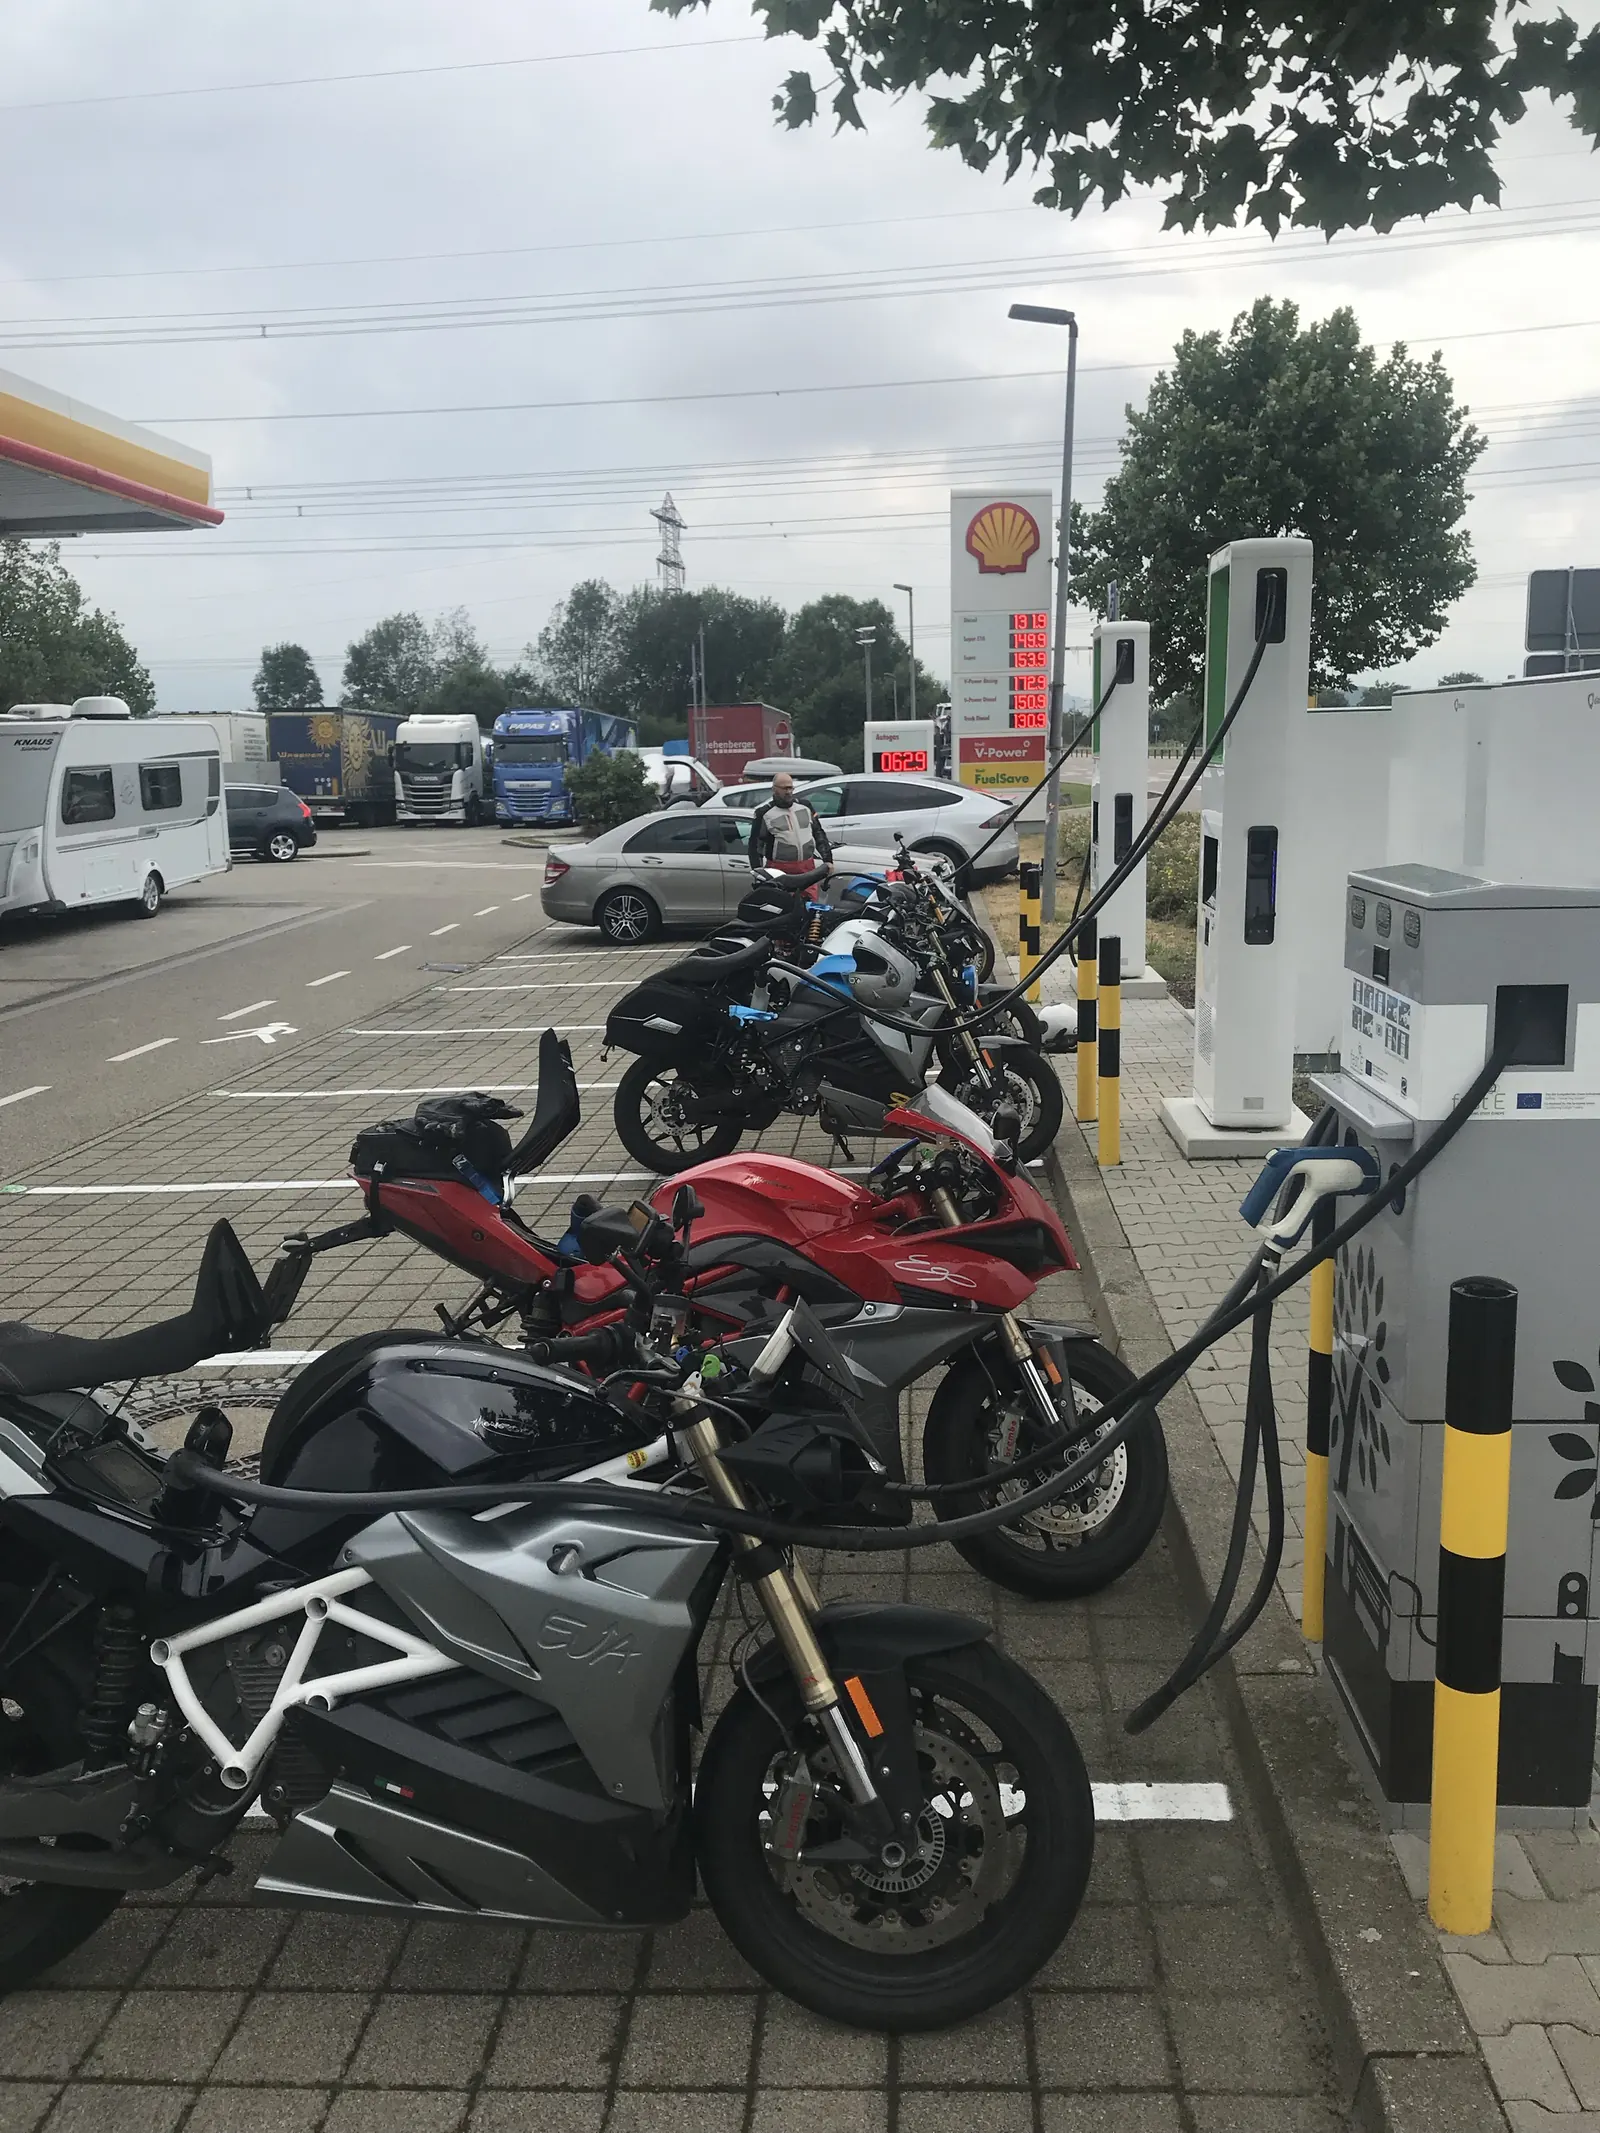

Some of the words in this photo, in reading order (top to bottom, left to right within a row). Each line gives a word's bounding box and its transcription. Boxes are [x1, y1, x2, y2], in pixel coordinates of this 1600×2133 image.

[1014, 613, 1047, 630] 131.9
[1014, 633, 1047, 649] 149.9
[1014, 652, 1047, 668] 153.9
[1014, 675, 1047, 691] 172.9
[1014, 694, 1047, 710] 150.9
[1014, 713, 1047, 729] 130.9
[13, 738, 54, 746] KNAUS
[876, 733, 899, 742] Autogas
[974, 747, 1028, 758] V-Power
[881, 751, 927, 772] 062.9
[975, 772, 1030, 784] FuelSave
[1004, 1419, 1018, 1458] brembo
